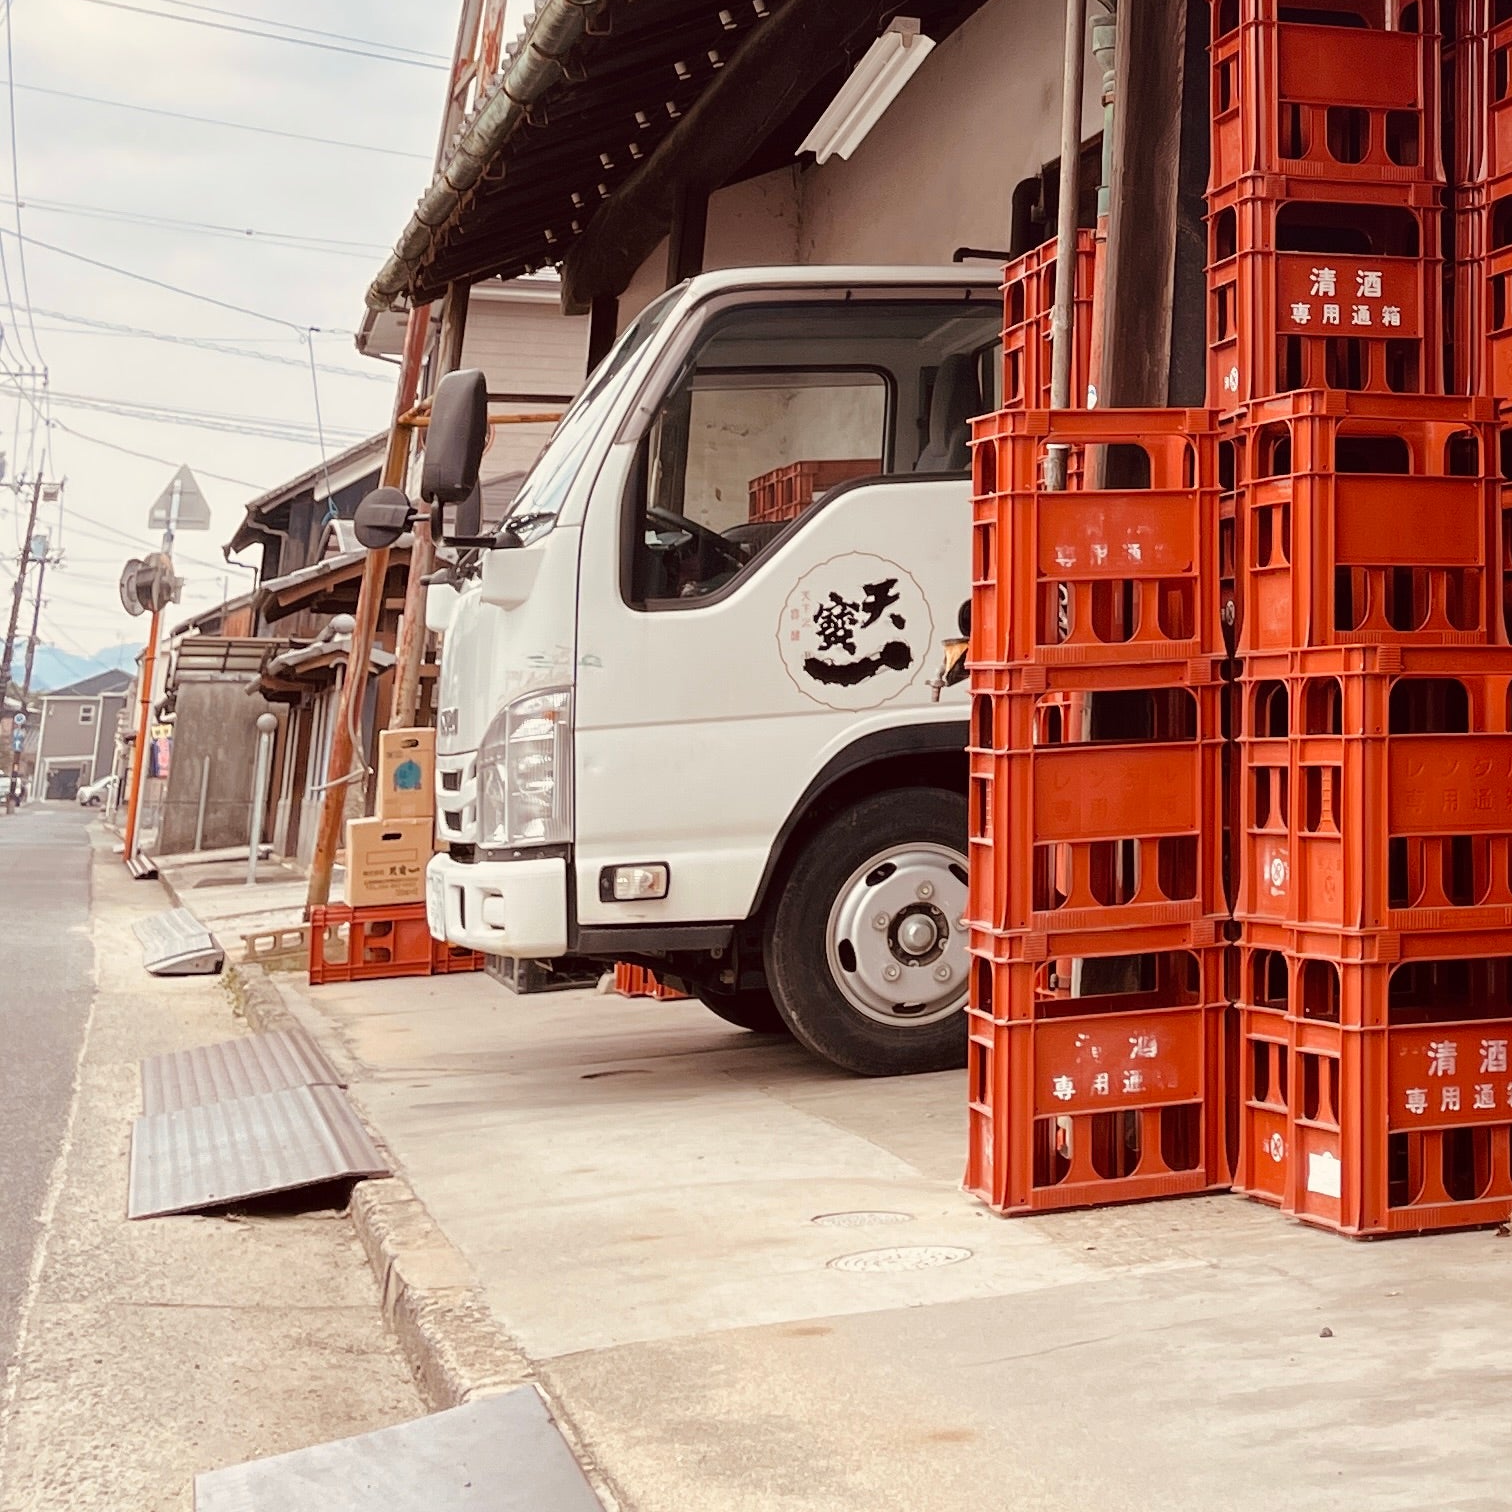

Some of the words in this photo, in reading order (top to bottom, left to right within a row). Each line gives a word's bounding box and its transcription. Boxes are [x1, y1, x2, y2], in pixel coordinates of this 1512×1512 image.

[1309, 268, 1384, 299] 清酒
[1290, 302, 1402, 328] 専用通箱
[1428, 1039, 1508, 1077] 清酒
